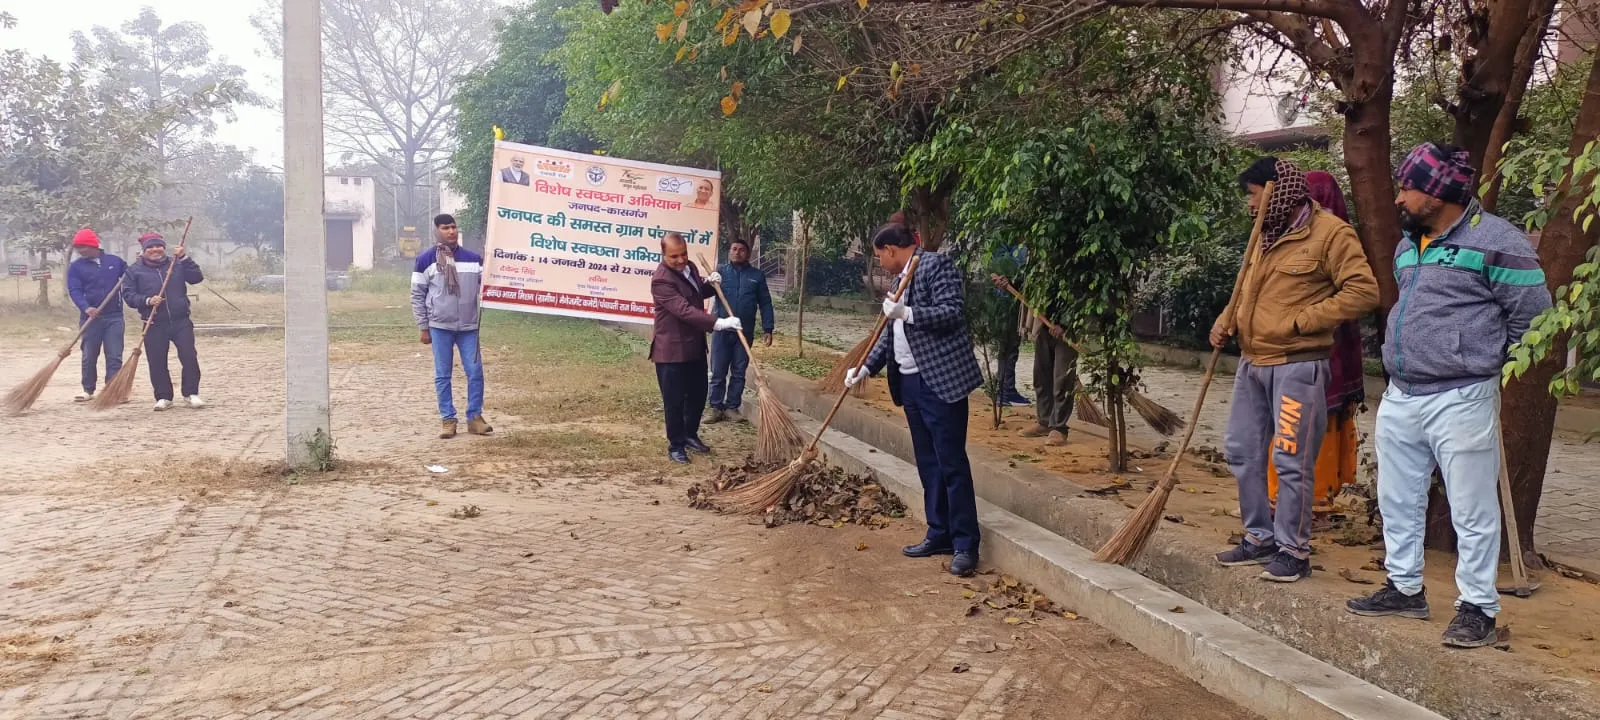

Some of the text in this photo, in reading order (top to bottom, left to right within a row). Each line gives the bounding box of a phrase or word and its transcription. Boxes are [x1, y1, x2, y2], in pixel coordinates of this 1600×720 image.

[535, 179, 682, 211] विशेष स्वच्छता अभियान
[568, 201, 648, 219] जनपद-कासगंज
[497, 206, 543, 225] जनपद
[547, 211, 565, 227] की
[570, 217, 611, 234] समस्त
[615, 223, 643, 237] ग्राम
[699, 231, 714, 246] में
[494, 248, 528, 262] दिनांक
[538, 256, 548, 264] 14
[551, 257, 586, 269] जनवरी
[588, 262, 607, 271] 2024
[610, 263, 619, 273] से
[622, 266, 632, 275] 22
[530, 233, 663, 263] विशेष स्वच्छता अभिय
[1275, 394, 1303, 455] NIKE
